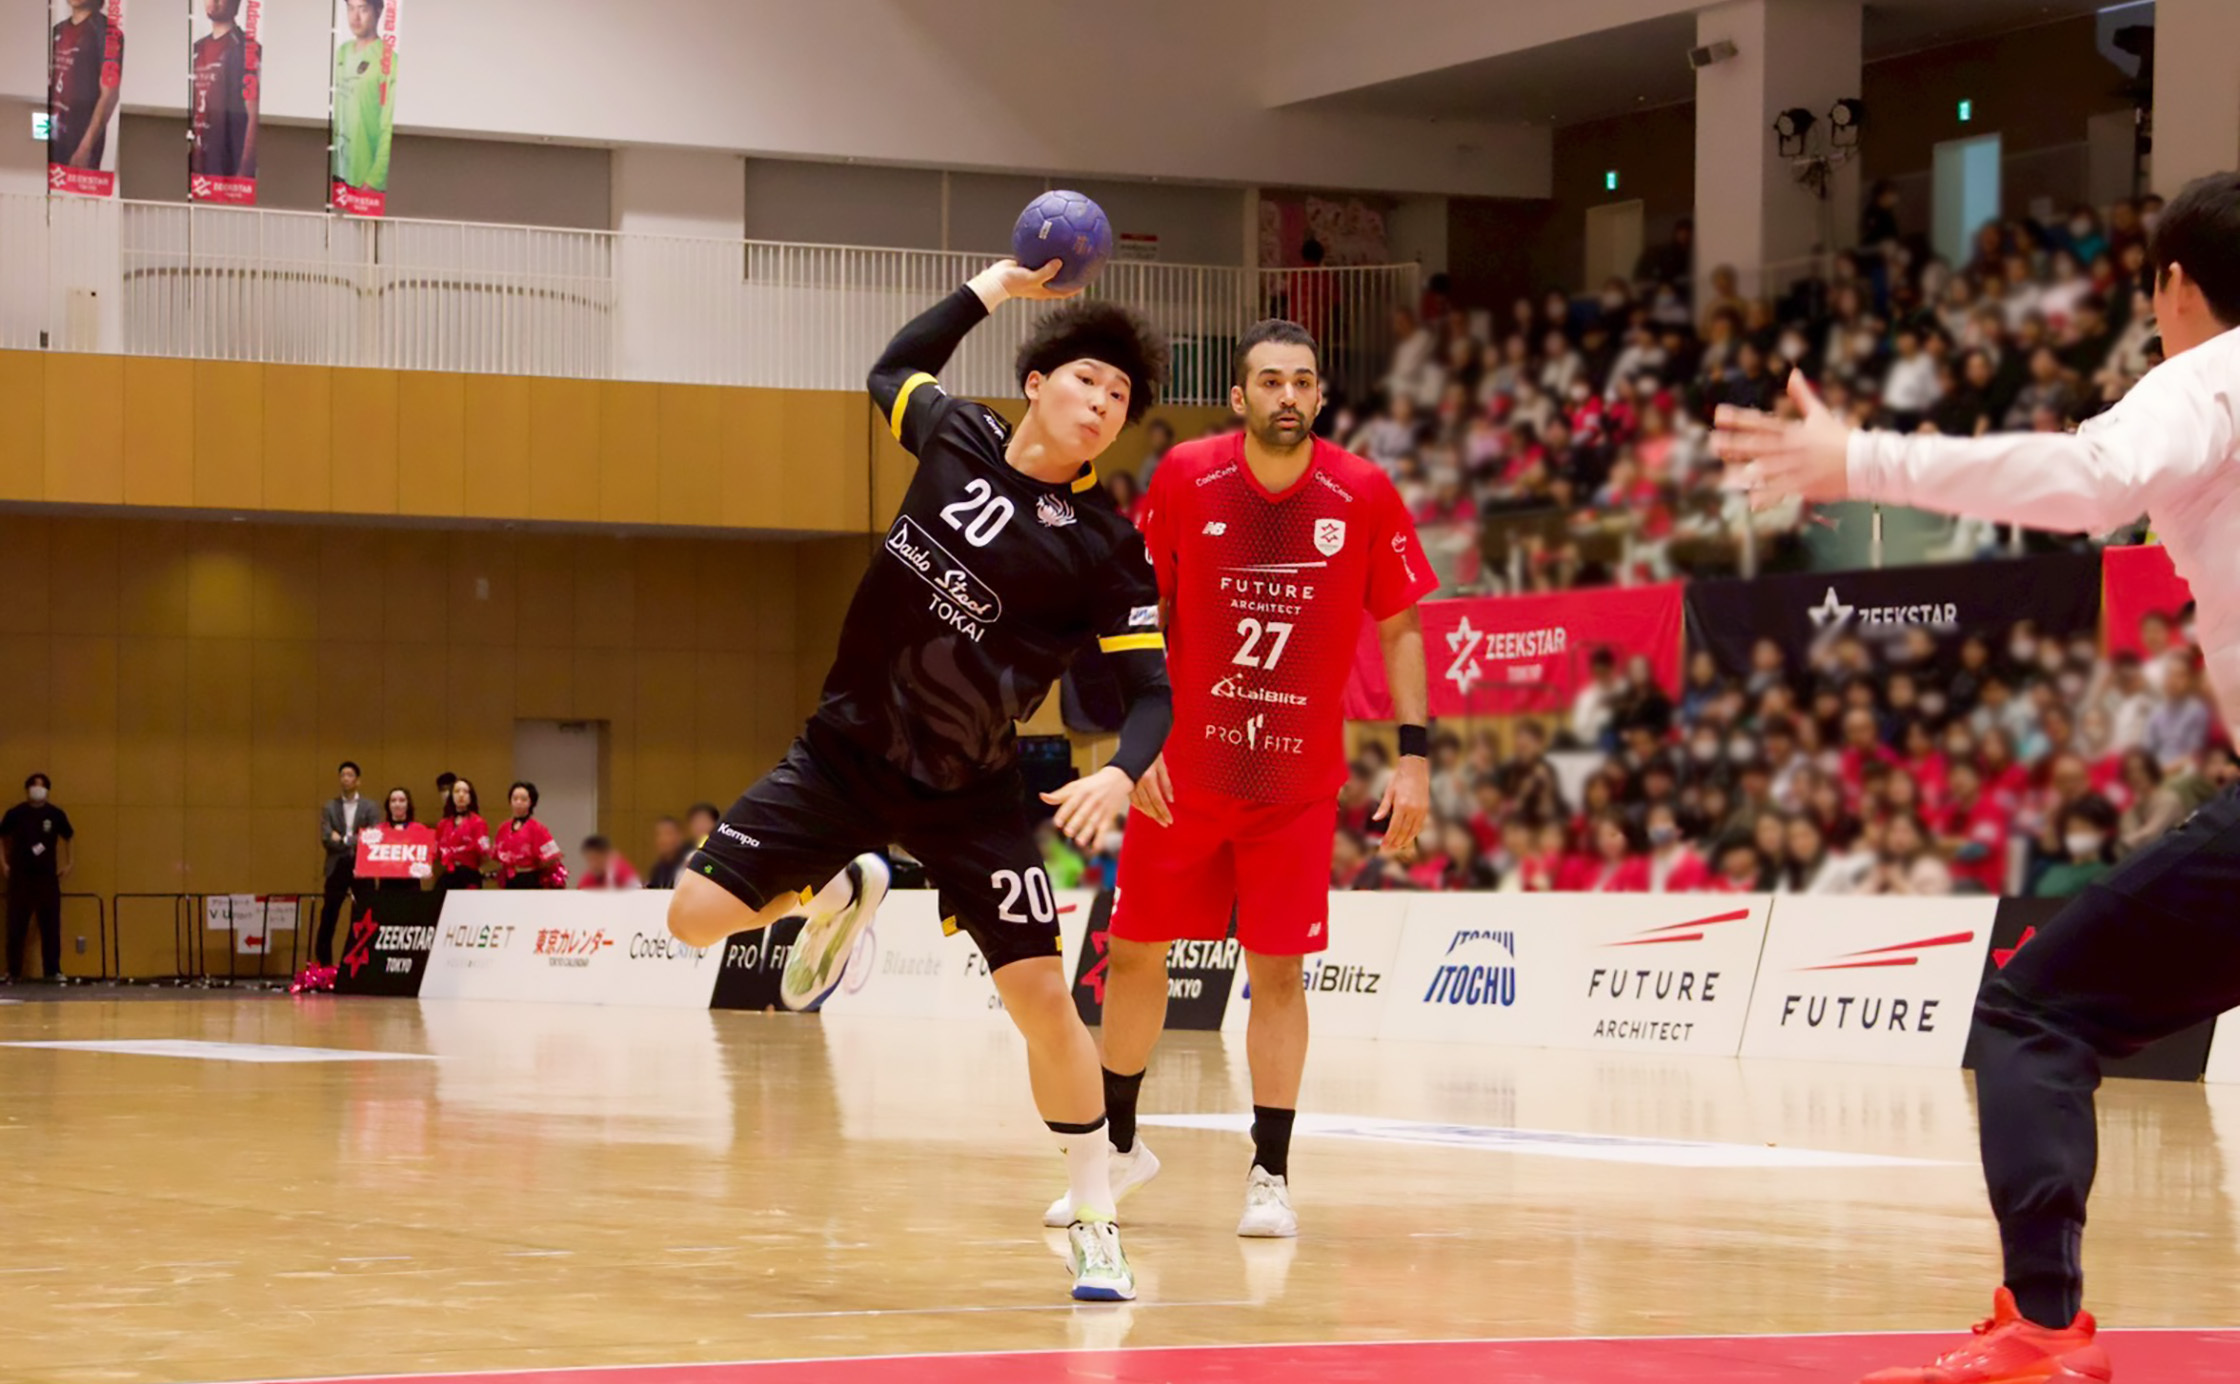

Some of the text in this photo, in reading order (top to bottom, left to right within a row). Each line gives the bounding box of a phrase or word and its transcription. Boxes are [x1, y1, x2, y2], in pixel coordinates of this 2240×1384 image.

[1195, 463, 1238, 487] CodeCamp
[1315, 470, 1353, 503] CodeCamp
[939, 478, 1015, 548] 20
[888, 523, 992, 615] Daido Steel
[1220, 577, 1315, 600] FUTURE
[928, 593, 985, 643] TOKAI
[1231, 600, 1302, 615] ARCHITECT
[1232, 618, 1294, 671] 27
[1486, 627, 1566, 660] ZEEKSTAR
[1237, 685, 1307, 706] LaiBlitz
[1206, 724, 1303, 754] PRO FITZ
[717, 822, 760, 849] Kempa
[367, 844, 428, 862] ZEEK!!
[991, 866, 1054, 924] 20
[375, 925, 435, 951] ZEEKSTAR
[444, 925, 515, 949] HOUSET
[533, 928, 614, 955] 東京カレンダー
[385, 957, 413, 973] TOKYO
[726, 945, 794, 970] PRO FIT
[882, 950, 941, 976] Blanche
[1166, 938, 1239, 969] KSTAR
[1167, 979, 1202, 998] OKYO
[1303, 959, 1381, 993] aiBlitz
[1423, 965, 1516, 1007] ITOCHU
[1588, 969, 1720, 1001] FUTURE
[1781, 995, 1940, 1033] FUTURE
[1593, 1019, 1693, 1041] ARCHITECT
